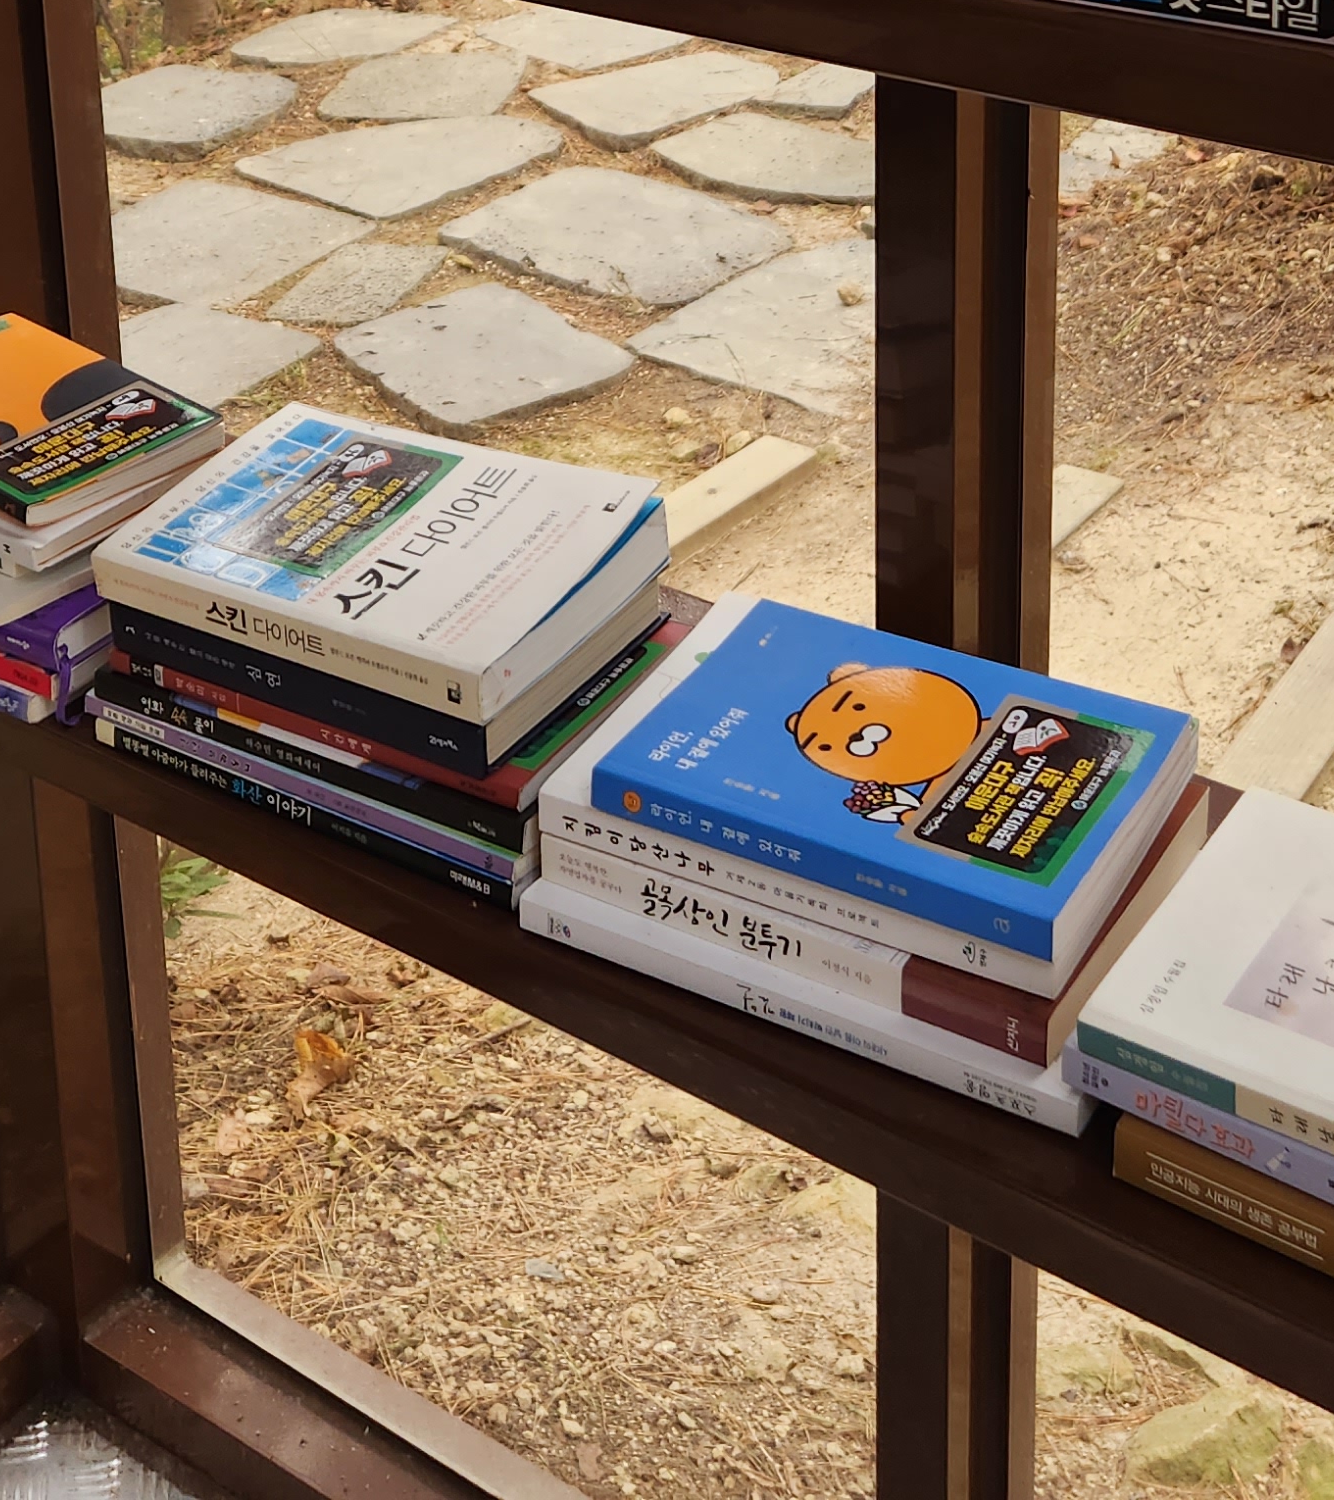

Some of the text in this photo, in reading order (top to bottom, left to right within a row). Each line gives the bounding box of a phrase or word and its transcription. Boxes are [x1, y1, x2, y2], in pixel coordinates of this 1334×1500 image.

[337, 466, 517, 620] 스킨 다이어트
[206, 602, 249, 636] 스킨
[253, 619, 326, 657] 다이어트
[245, 665, 281, 688] 심연
[140, 697, 215, 734] 영화 풀이
[648, 729, 694, 763] 라이언,
[676, 708, 750, 771] 내 곁에 있어줘
[121, 736, 150, 758] 별똥별
[152, 748, 189, 772] 아줌마가
[192, 763, 228, 788] 들려주는
[232, 779, 262, 804] 화산
[267, 794, 312, 826] 이야기
[962, 759, 1018, 810] 해운대구
[965, 753, 1048, 844] 숲속도서관 책입니다.
[987, 768, 1066, 850] 깨끗하게 읽고 꼭!
[1009, 755, 1098, 857] 제자리에 반납해주세요.
[699, 819, 714, 833] 내
[721, 826, 750, 847] 곁에
[757, 836, 802, 862] 있어줘
[449, 870, 491, 894] 미래M&B
[640, 878, 730, 940] 골목상인
[740, 916, 802, 960] 분투기
[1265, 963, 1306, 1008] 타래
[1134, 1091, 1256, 1160] 마틸다 효과
[1149, 1162, 1318, 1251] 인공지능 시대의 생존 공부법
